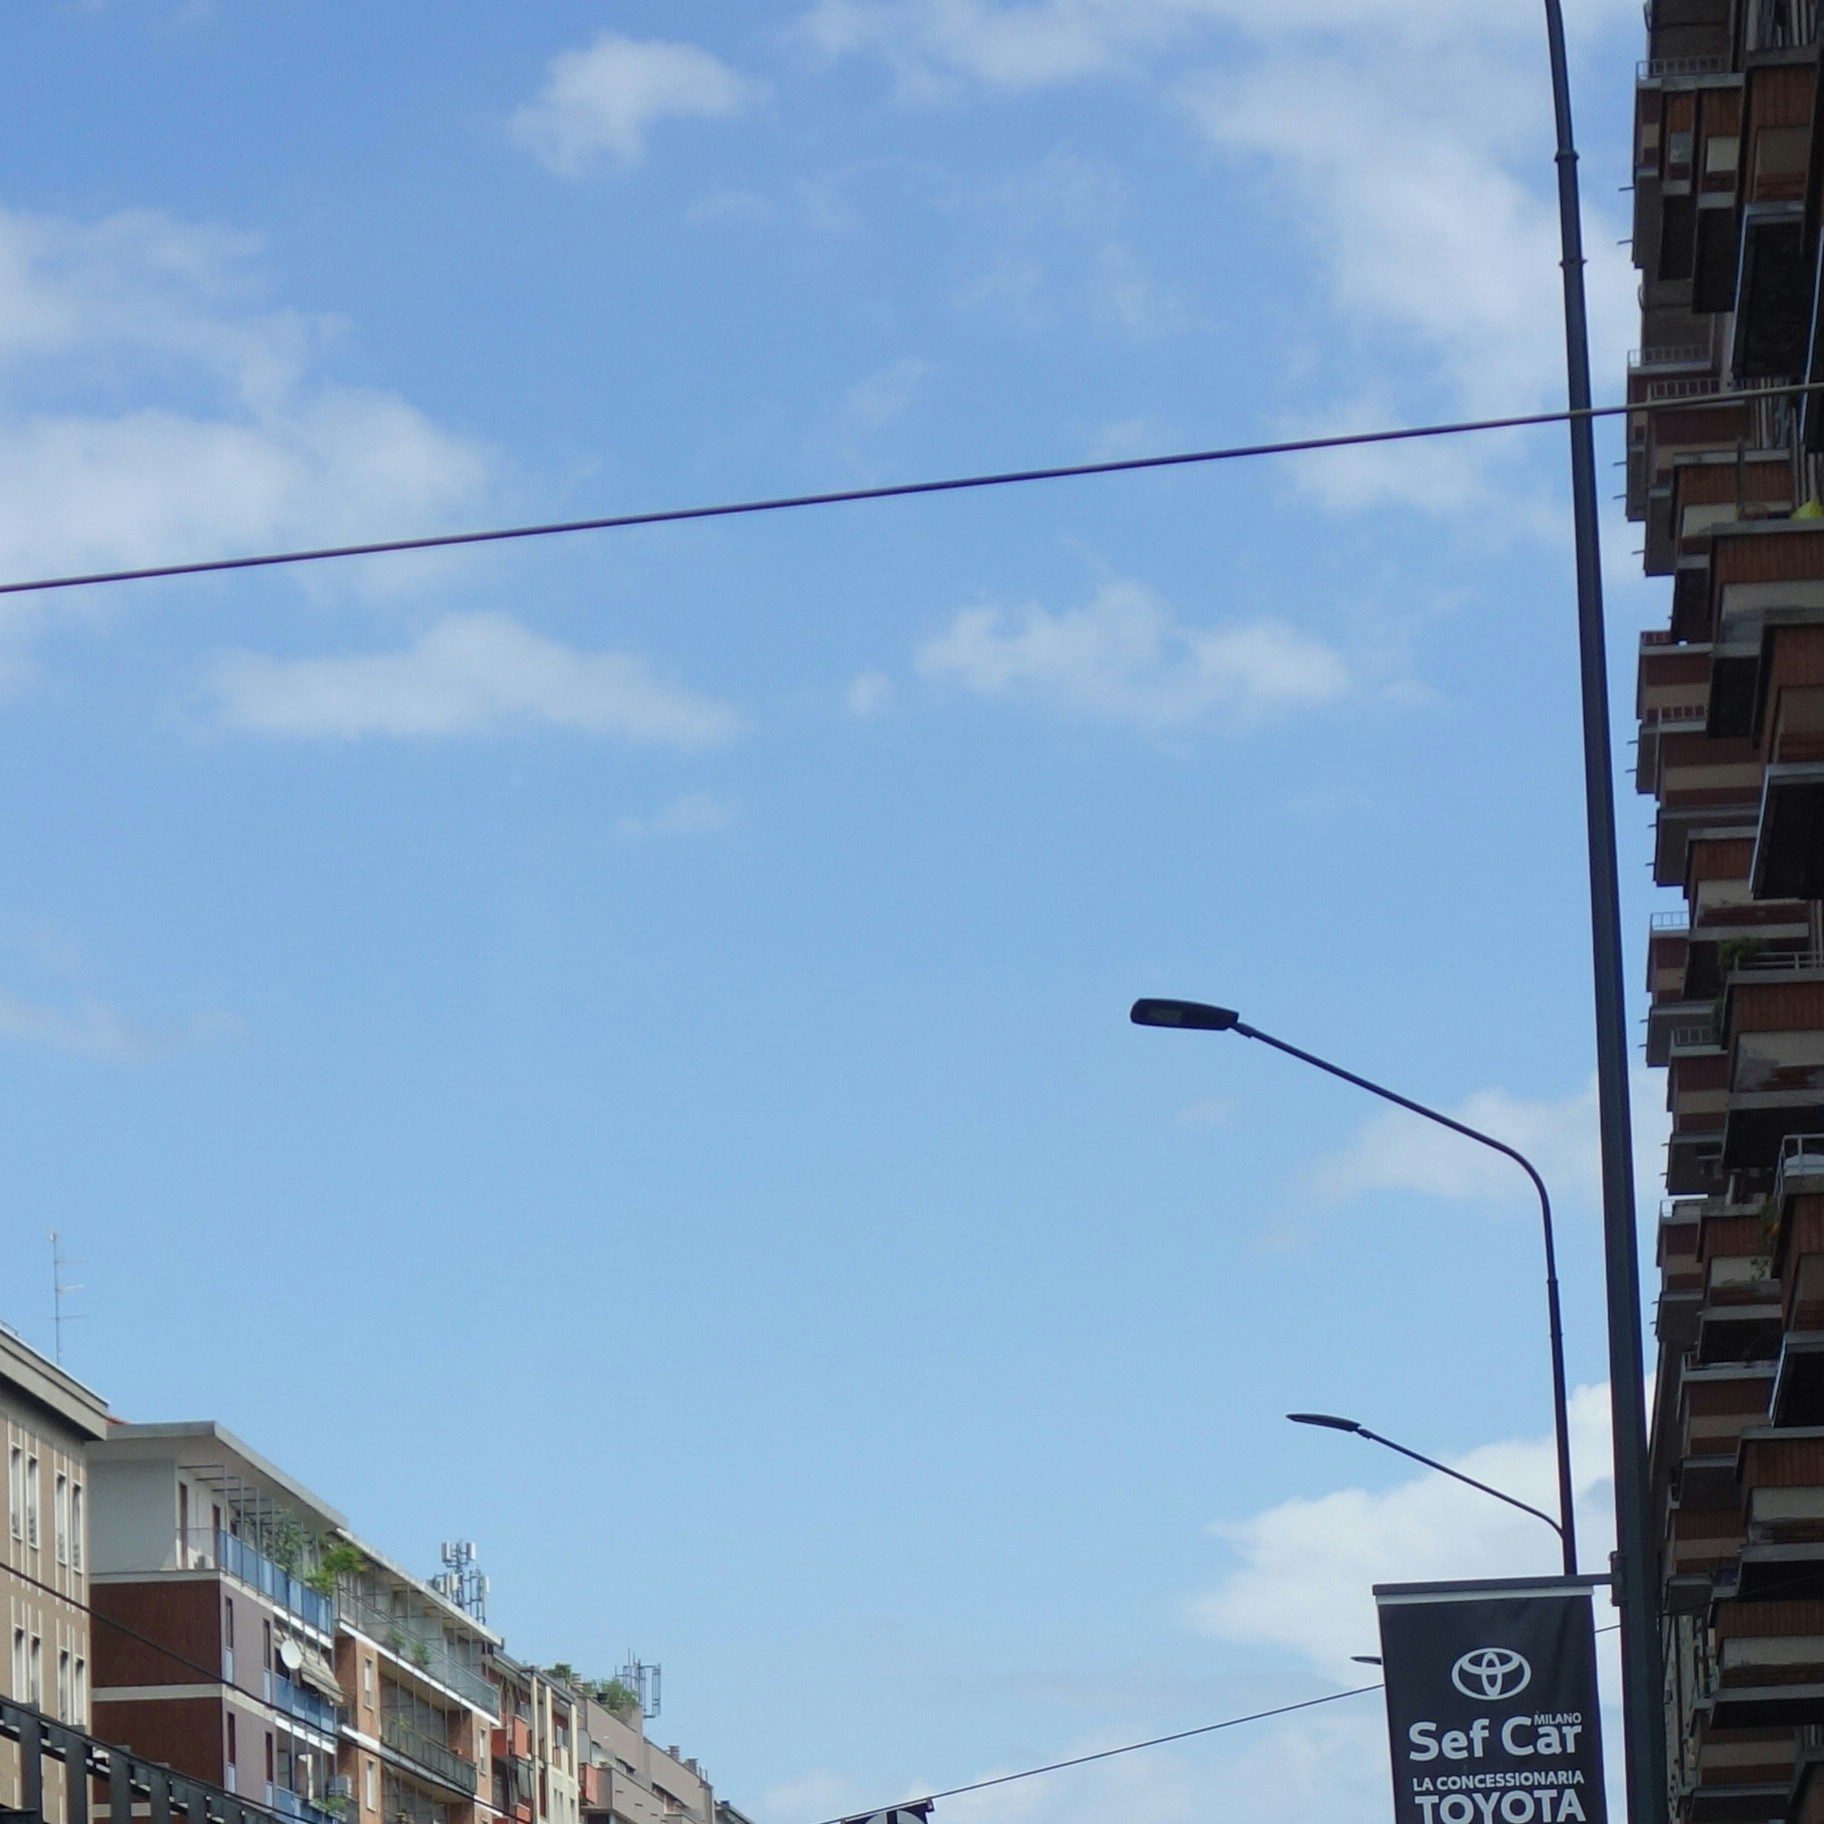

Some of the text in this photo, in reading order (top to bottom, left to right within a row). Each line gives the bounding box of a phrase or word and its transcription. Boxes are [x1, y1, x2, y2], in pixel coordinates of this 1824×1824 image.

[1534, 1711, 1582, 1726] MILANO
[1409, 1716, 1582, 1761] Sef Car
[1413, 1770, 1584, 1791] LA CONCESSIONARIA
